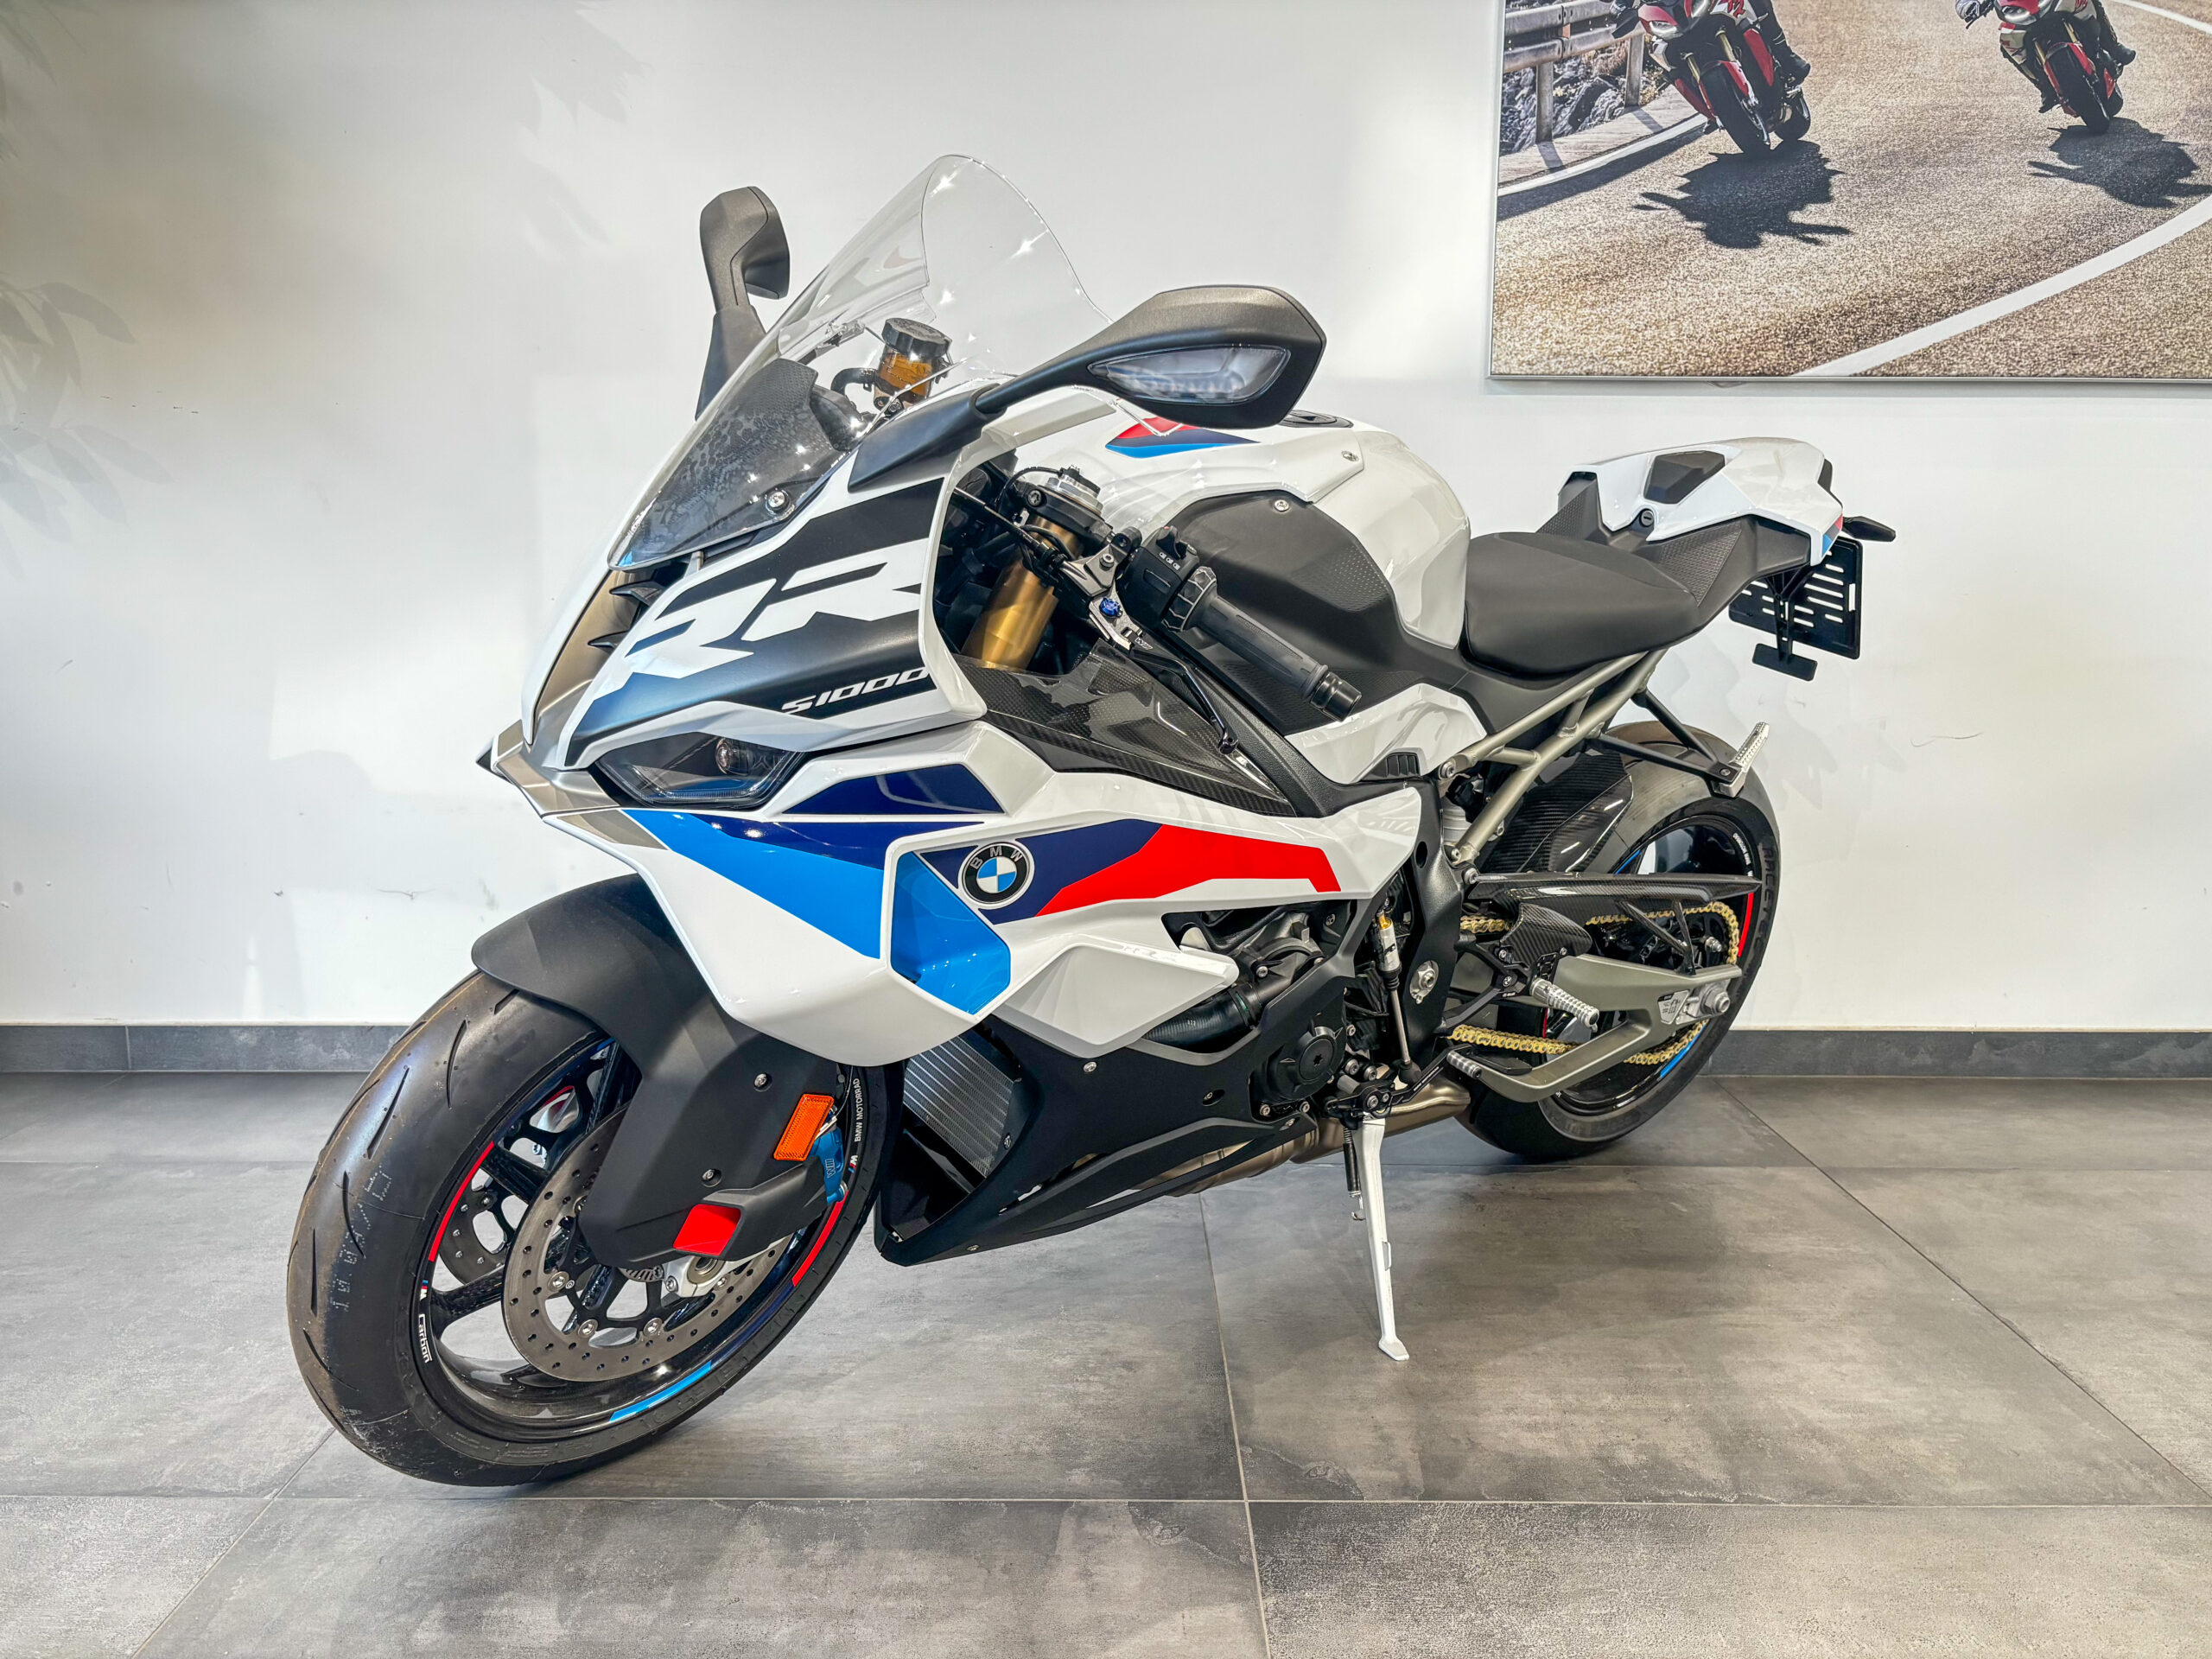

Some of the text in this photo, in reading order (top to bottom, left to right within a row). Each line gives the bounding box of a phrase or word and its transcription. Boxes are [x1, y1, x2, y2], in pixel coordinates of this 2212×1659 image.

[781, 666, 930, 715] S1000
[969, 845, 1023, 870] BMW
[852, 1077, 864, 1121] MOTORRAD
[854, 1122, 863, 1142] BMW
